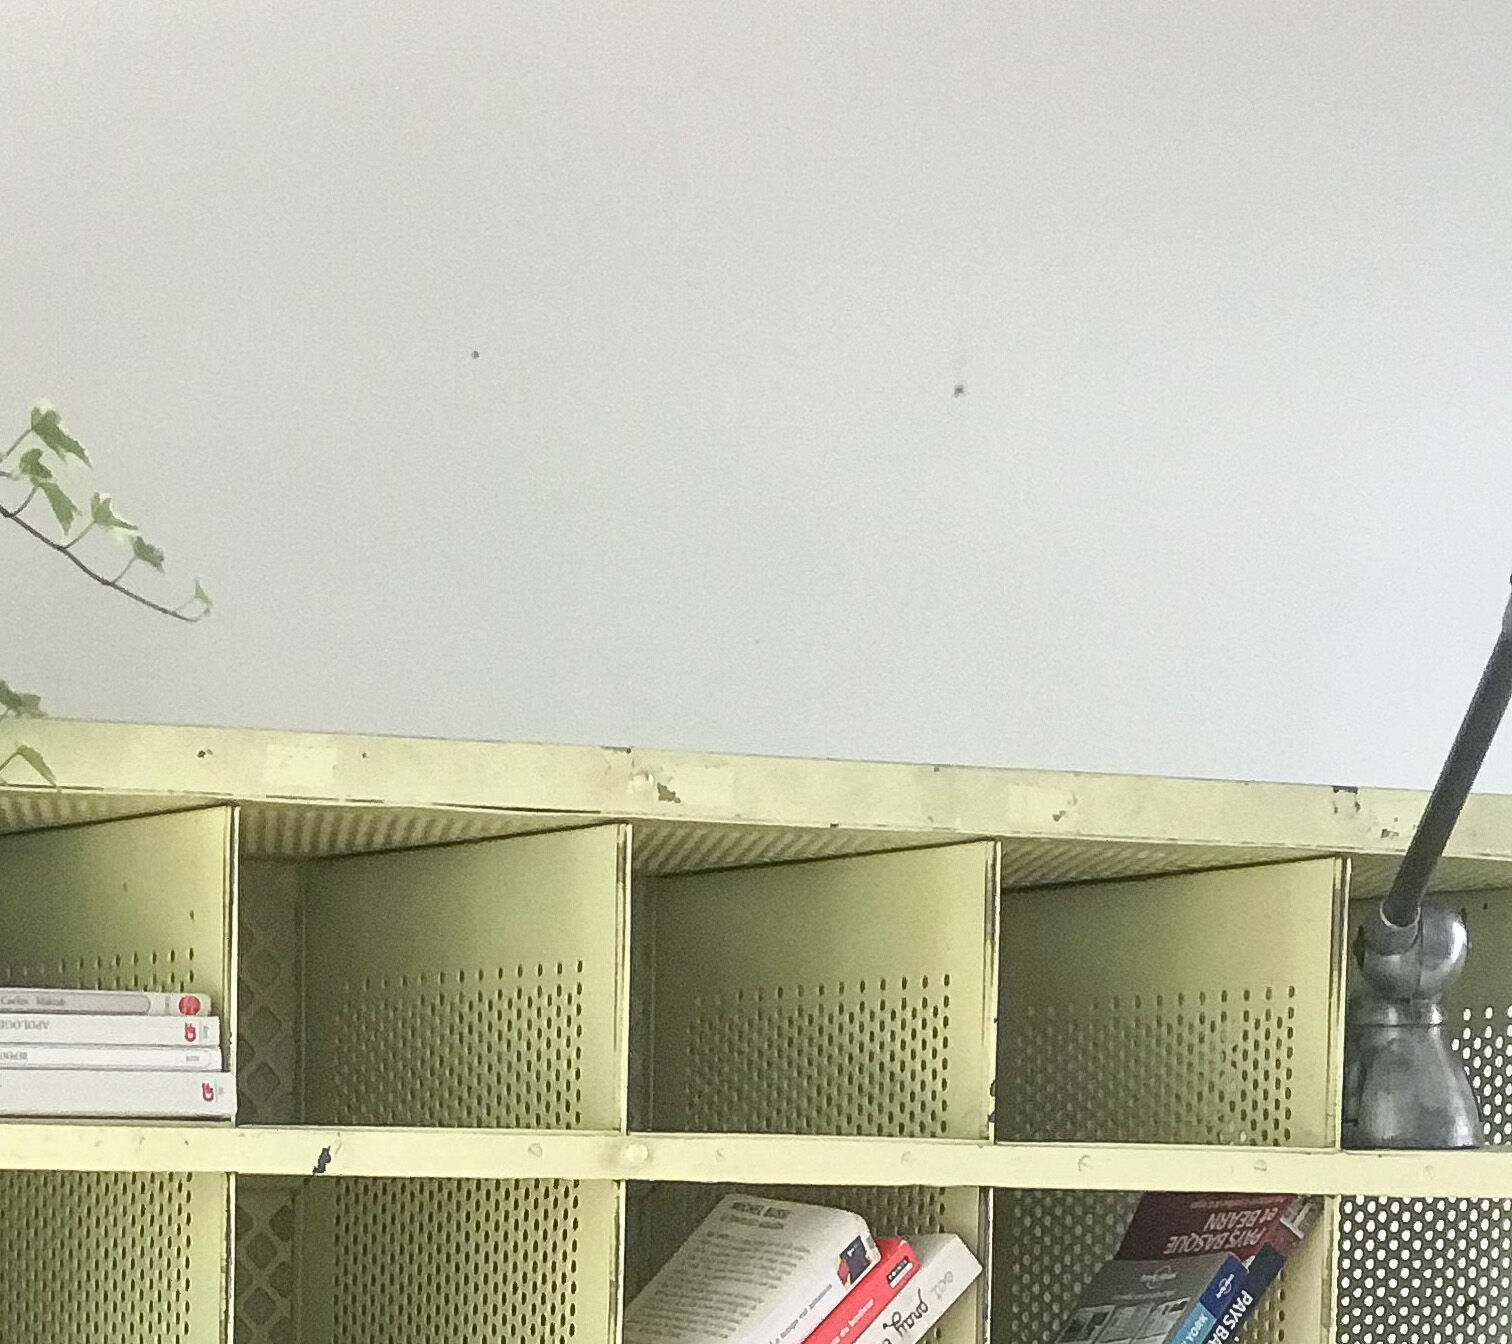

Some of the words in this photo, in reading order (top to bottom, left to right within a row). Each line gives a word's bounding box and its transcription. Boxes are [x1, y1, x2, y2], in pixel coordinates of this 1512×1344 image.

[1163, 1233, 1227, 1252] BASQUE
[1222, 1289, 1253, 1329] PAYS
[1185, 1313, 1207, 1342] YORK
